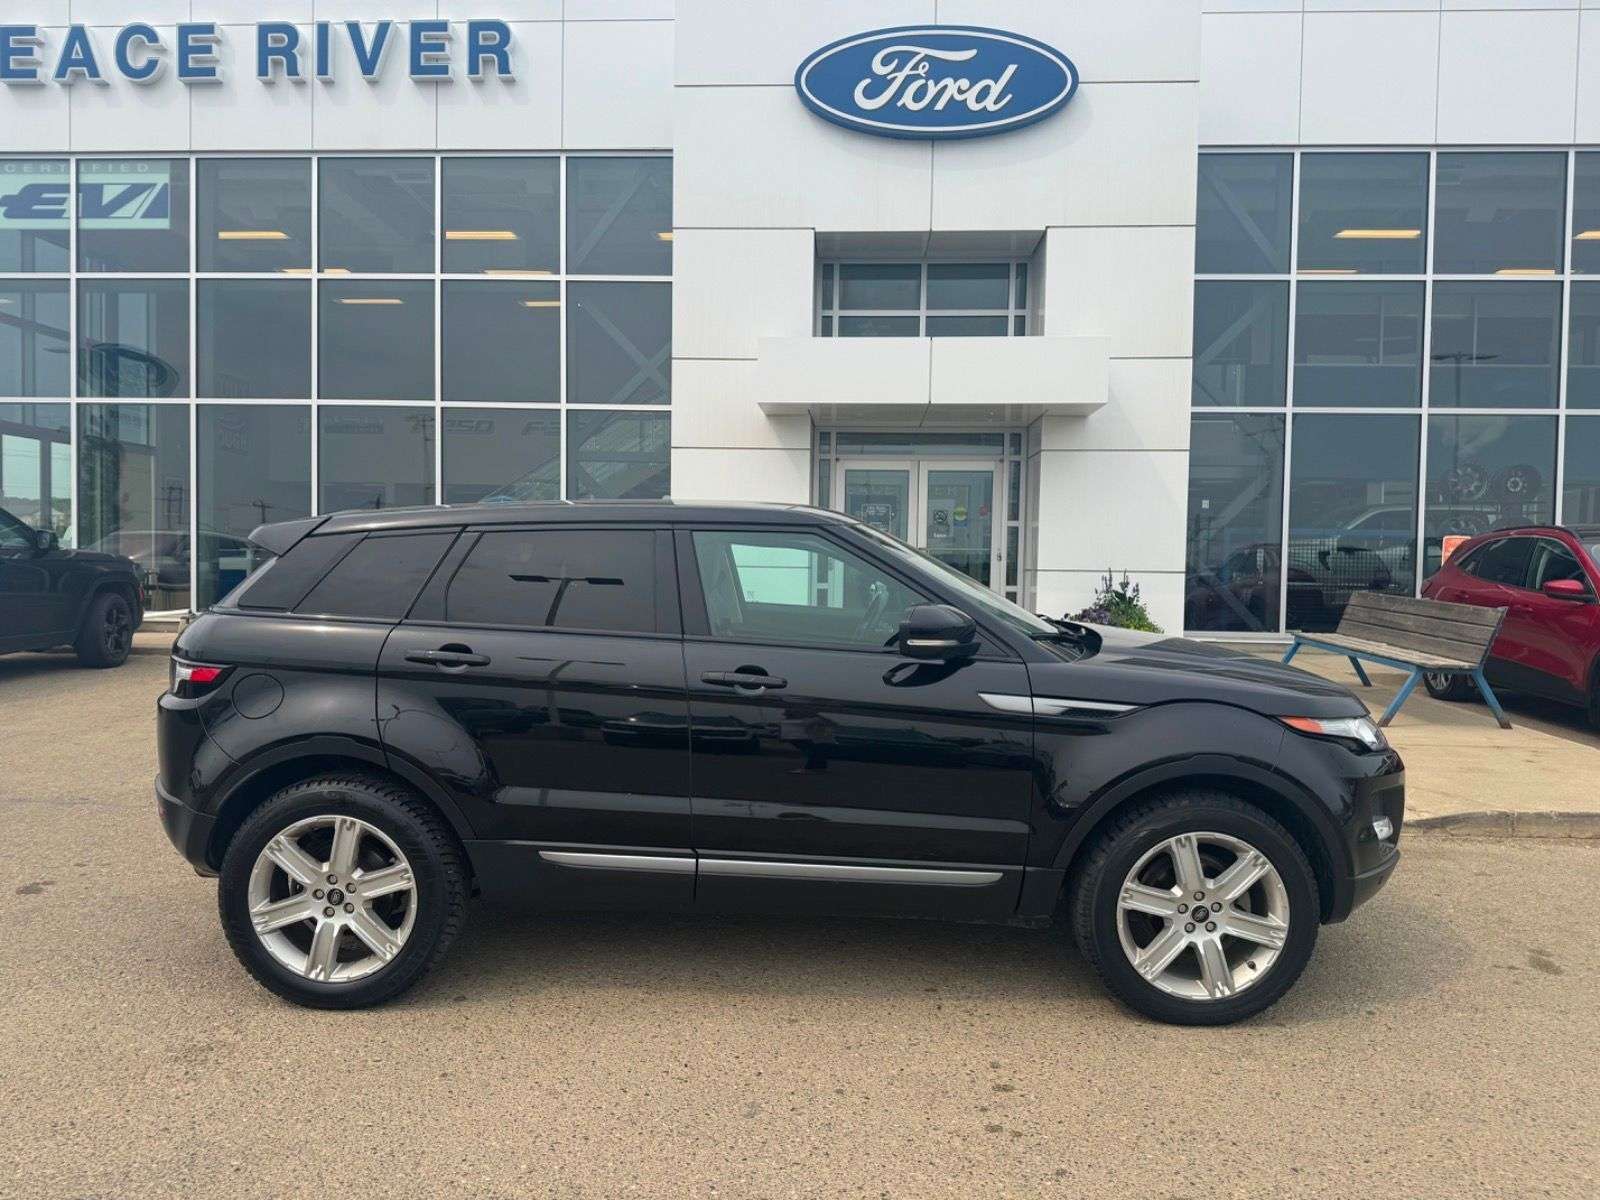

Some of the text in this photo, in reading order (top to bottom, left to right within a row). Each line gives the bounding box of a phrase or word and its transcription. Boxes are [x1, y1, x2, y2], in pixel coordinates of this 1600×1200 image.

[256, 19, 515, 83] RIVER
[854, 45, 1019, 112] Ford
[4, 162, 150, 173] CERTIFIED
